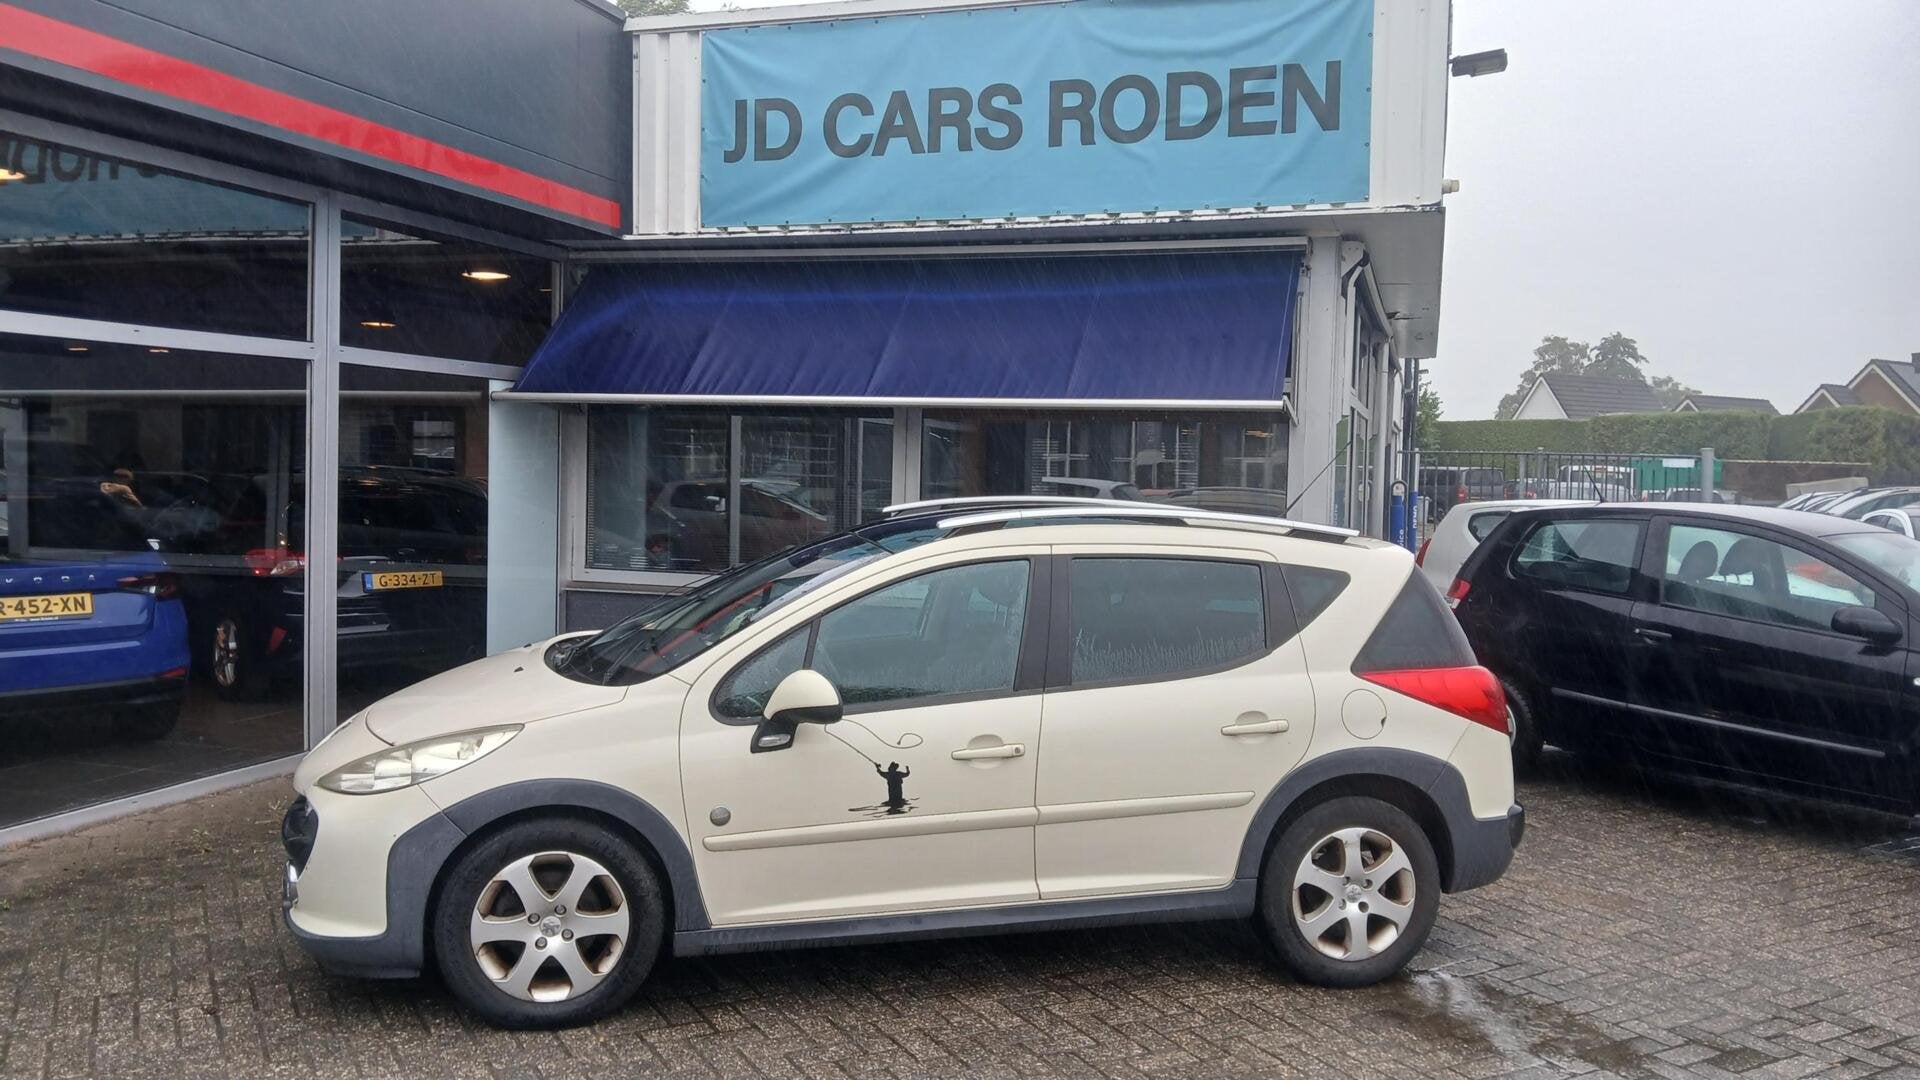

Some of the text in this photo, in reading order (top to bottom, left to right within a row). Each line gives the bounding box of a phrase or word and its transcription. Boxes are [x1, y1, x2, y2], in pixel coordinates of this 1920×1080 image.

[724, 60, 1341, 163] JD CARS RODEN
[379, 573, 436, 587] G-334-ZT
